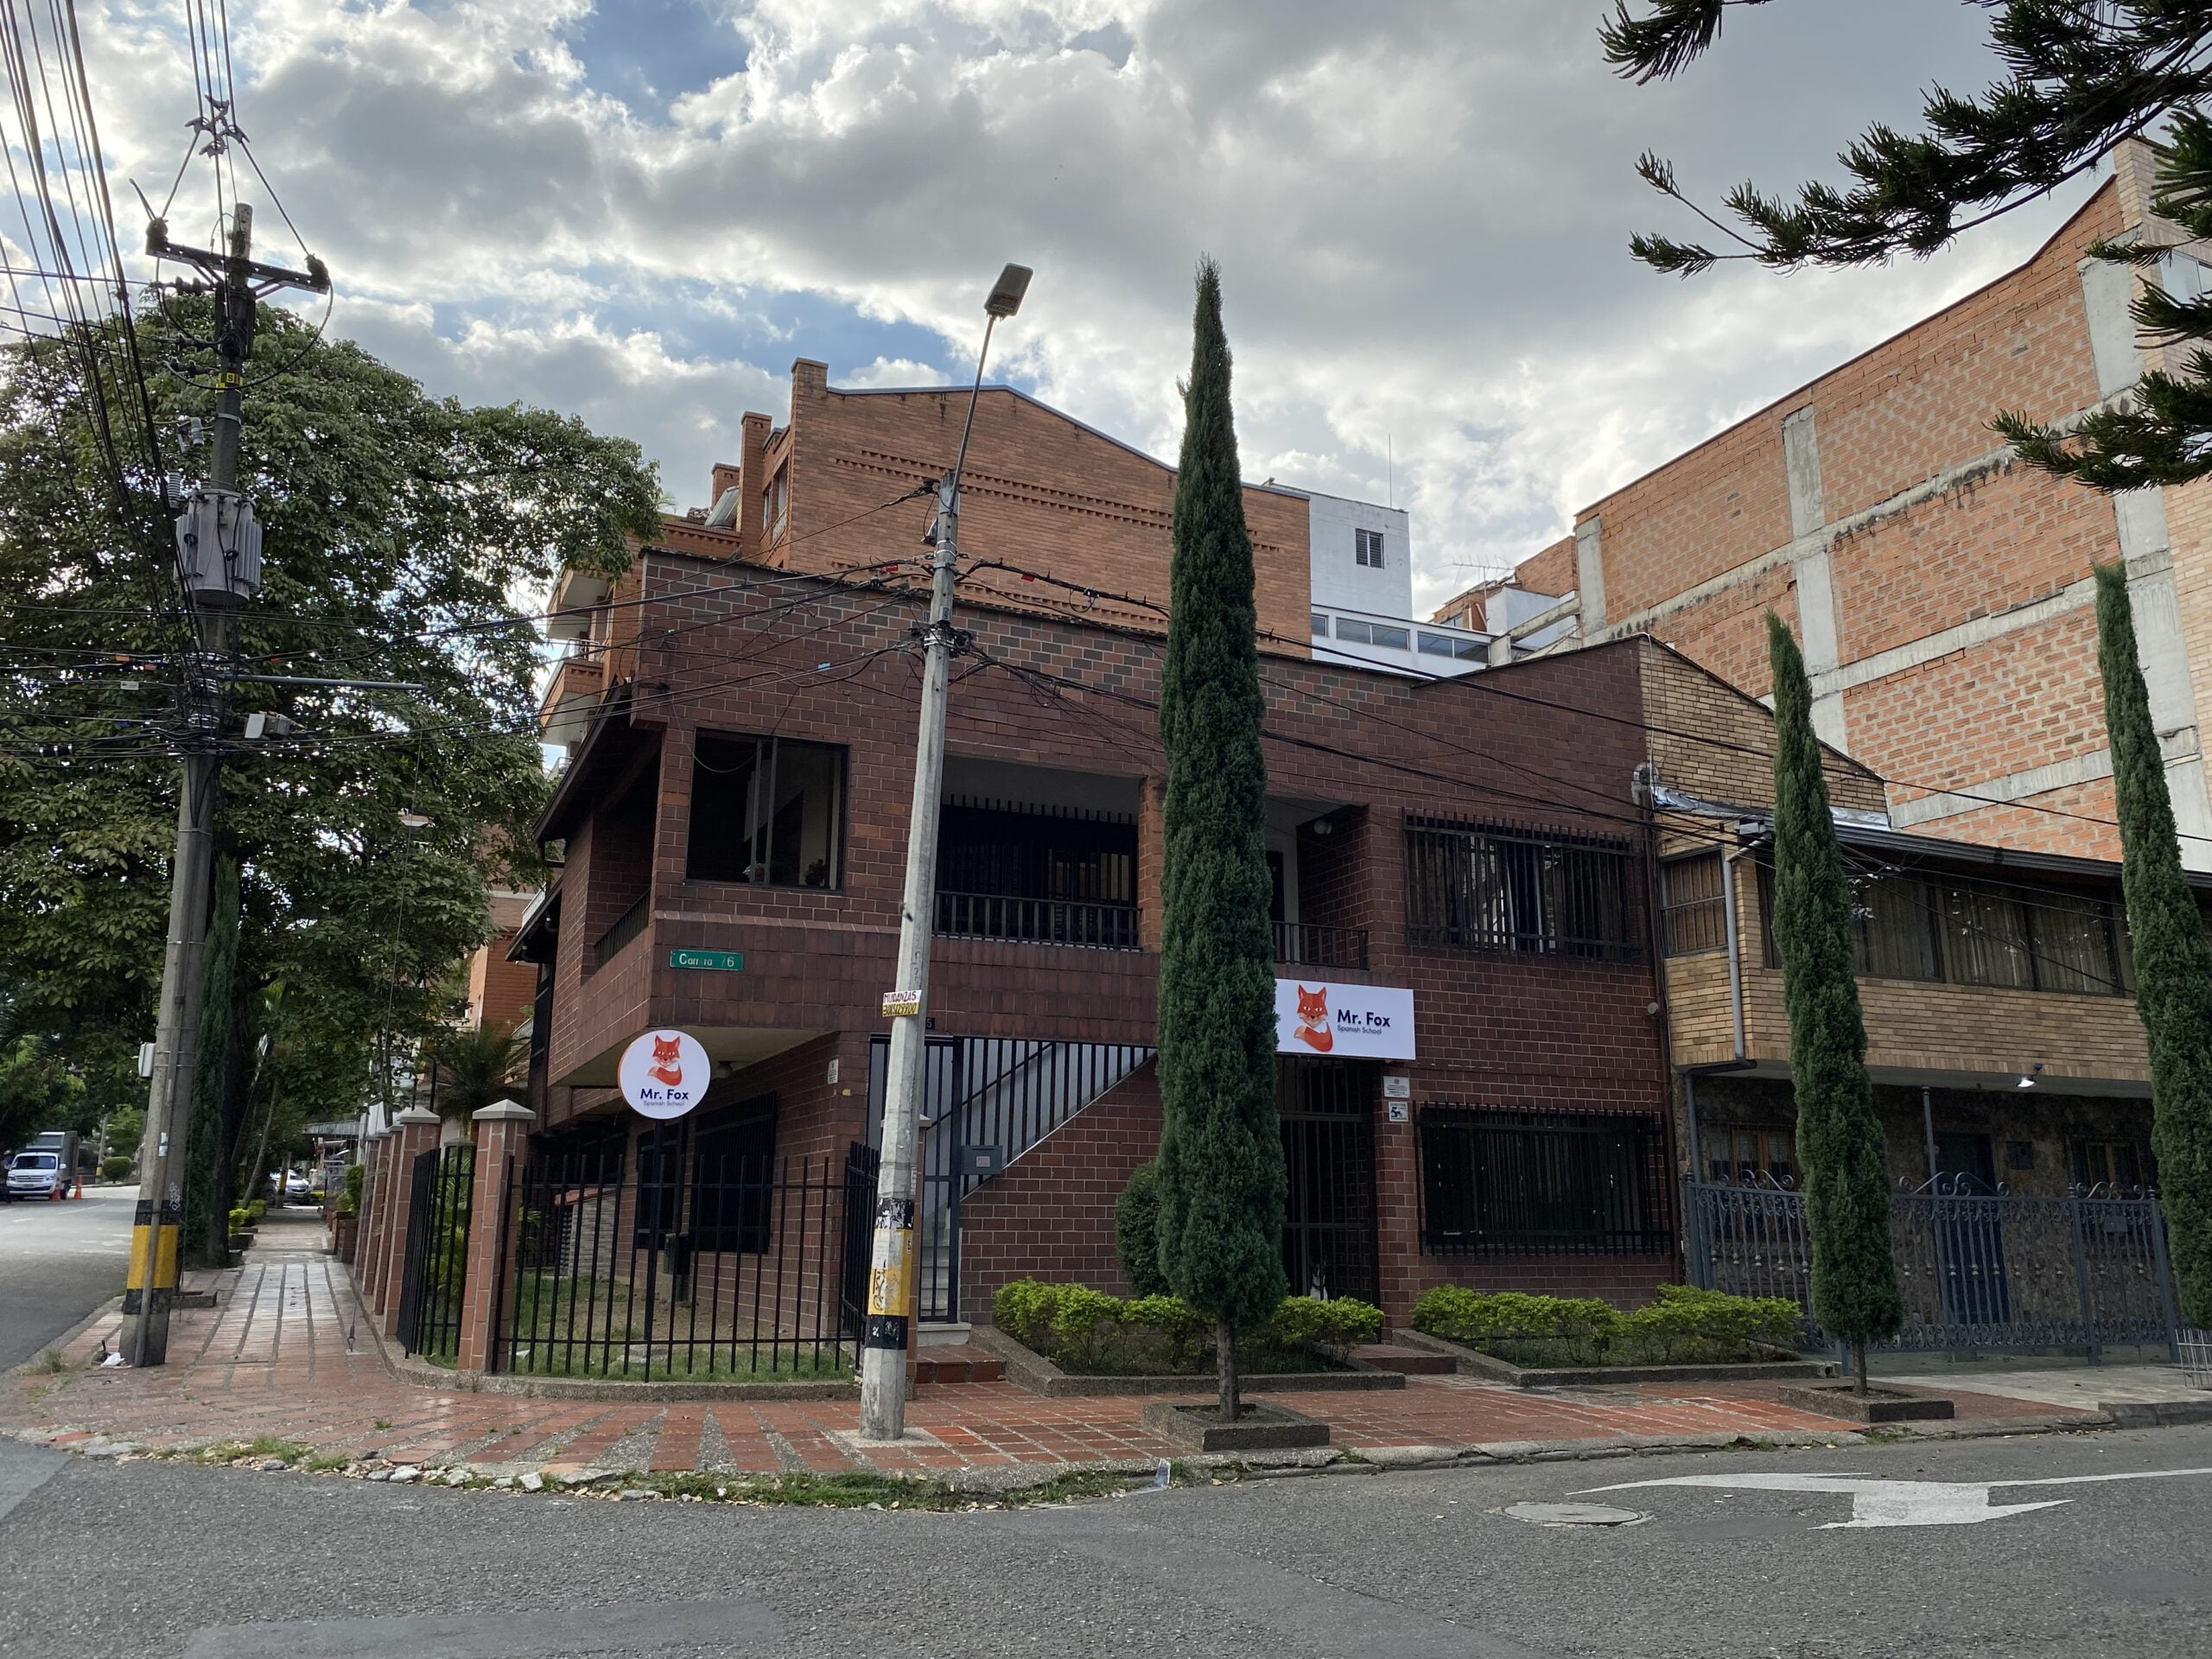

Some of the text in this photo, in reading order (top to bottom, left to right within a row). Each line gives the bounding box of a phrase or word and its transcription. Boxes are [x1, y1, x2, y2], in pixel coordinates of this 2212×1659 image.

[678, 953, 713, 966] Carrra
[883, 991, 917, 1003] MUDANZAS
[1337, 1008, 1390, 1027] Mr. Fox
[640, 1088, 689, 1100] Mr. Fox
